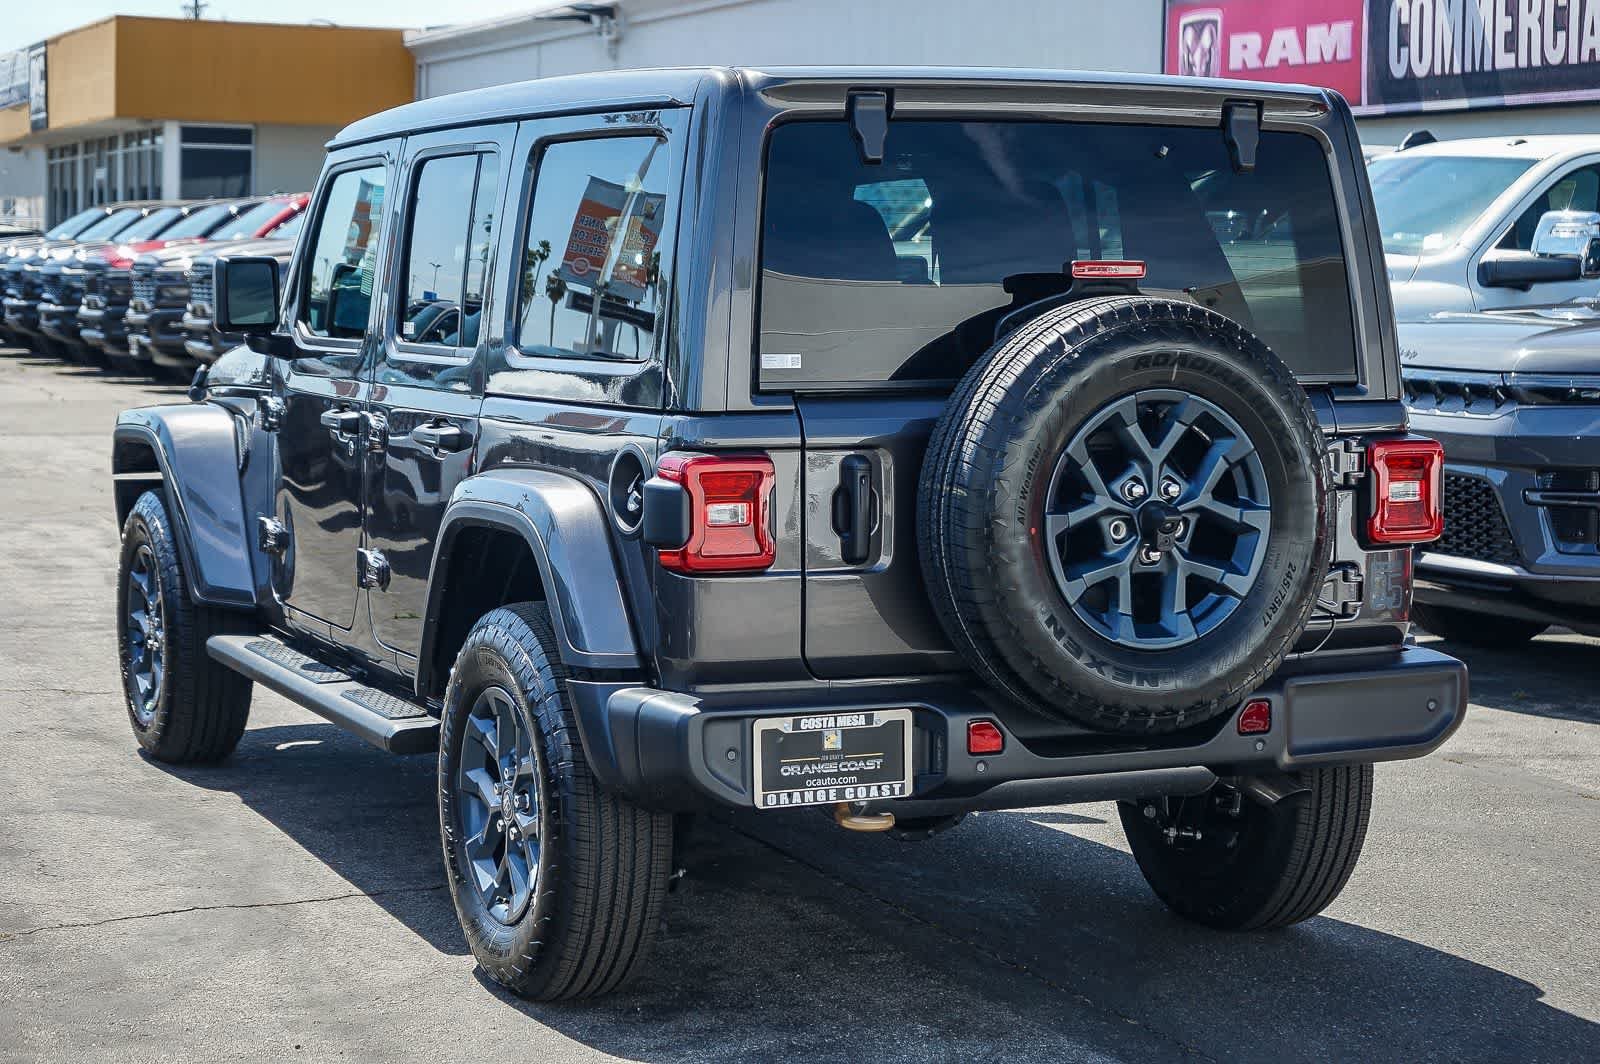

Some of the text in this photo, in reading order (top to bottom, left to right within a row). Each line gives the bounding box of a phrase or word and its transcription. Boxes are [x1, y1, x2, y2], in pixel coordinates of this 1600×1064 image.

[1229, 20, 1354, 72] RAM
[1017, 443, 1042, 526] All-Weather
[1262, 561, 1297, 628] 245/75R17
[1044, 614, 1161, 688] NEXEN
[800, 714, 866, 730] COSTA MESA
[780, 759, 883, 776] ORANGE COAST
[805, 775, 857, 787] ocauto.com
[767, 783, 902, 806] ORANGE COAST
